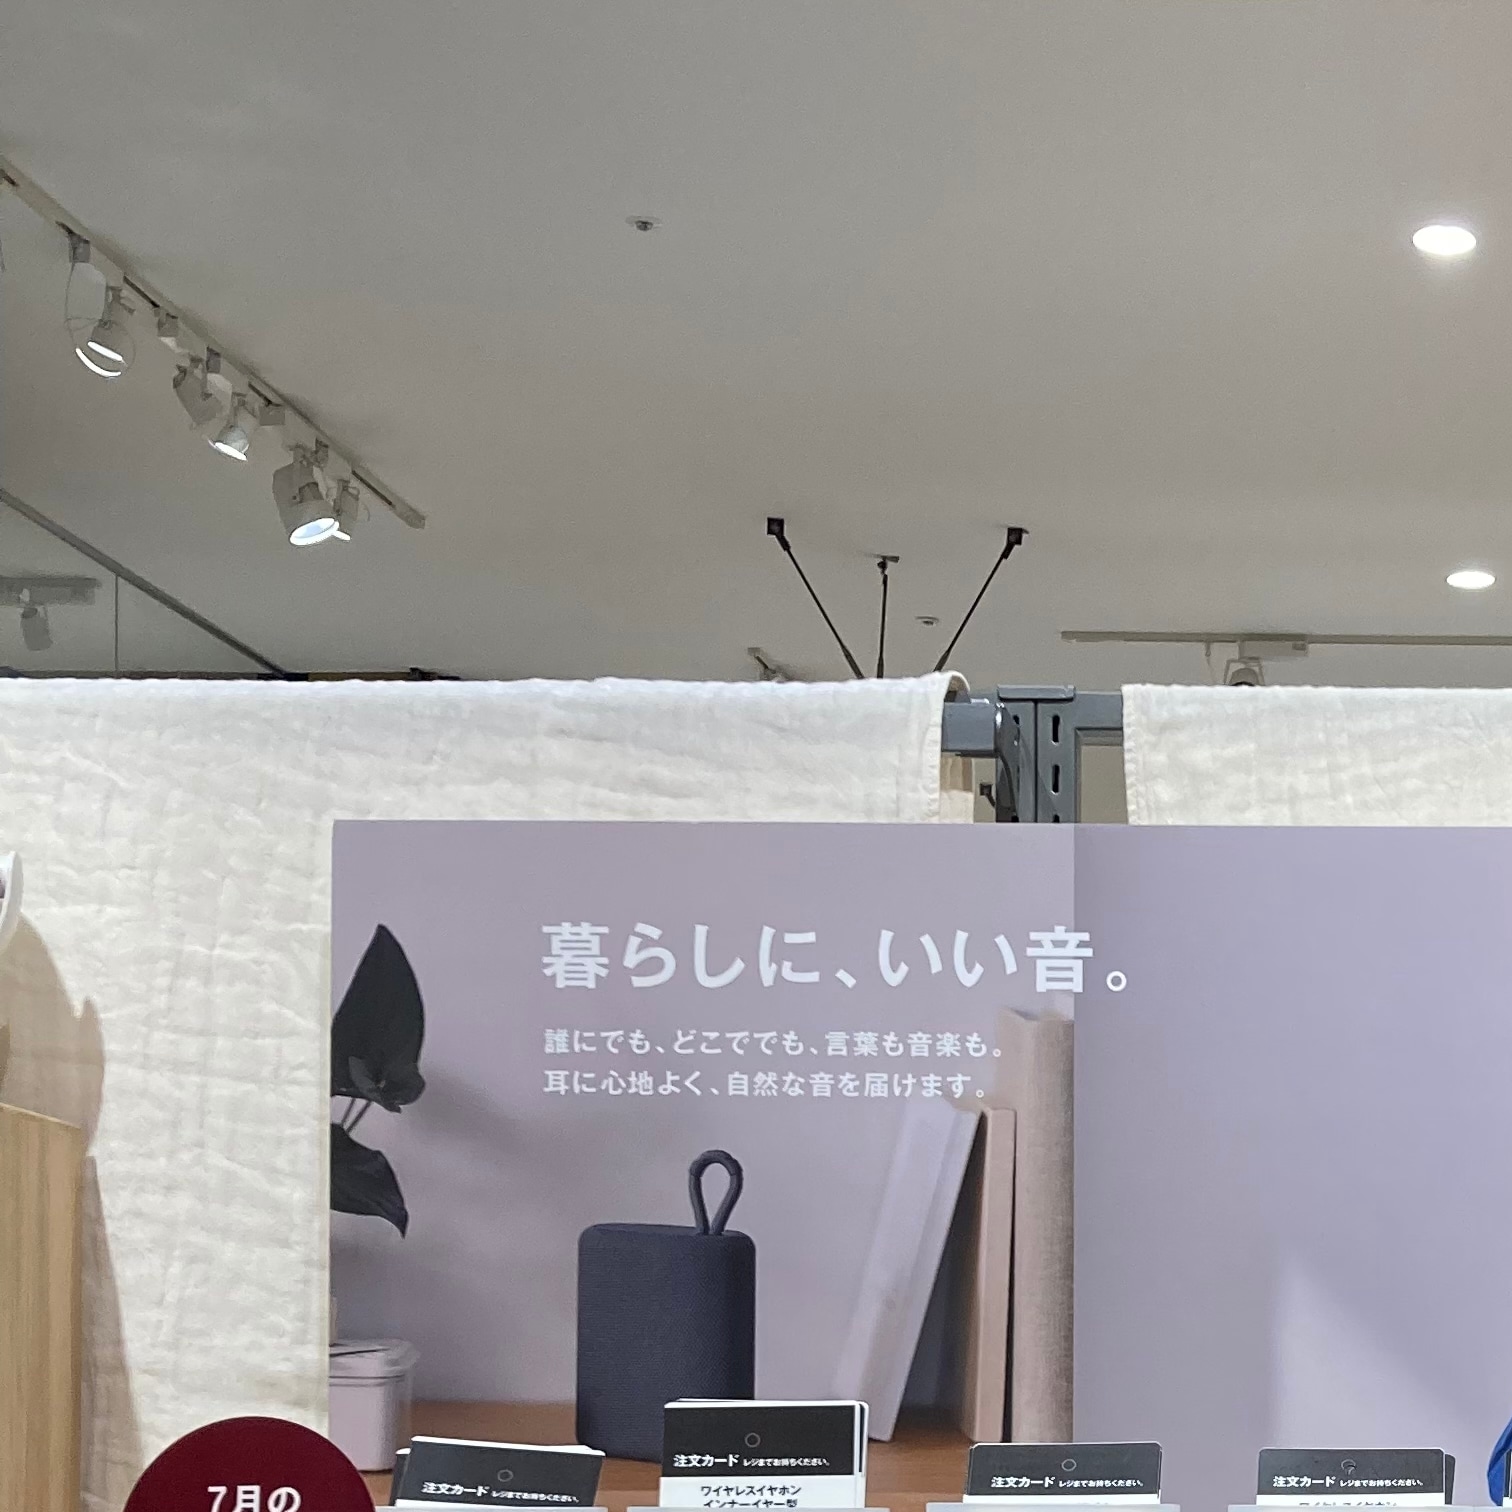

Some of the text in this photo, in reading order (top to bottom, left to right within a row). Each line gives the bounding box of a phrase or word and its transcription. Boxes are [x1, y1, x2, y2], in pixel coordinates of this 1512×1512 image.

[541, 921, 1127, 993] 暮らしに、いい音。
[543, 1028, 1002, 1058] 誰にでも、どこででも、言葉も音楽も。
[543, 1070, 985, 1099] 耳に心地よく、自然な音を届けます。
[673, 1454, 740, 1467] 注文カード
[991, 1476, 1056, 1488] 注文カード
[1272, 1475, 1336, 1488] 注文カード
[421, 1481, 490, 1497] 注文カード
[700, 1485, 802, 1497] ワイヤレスイヤホン
